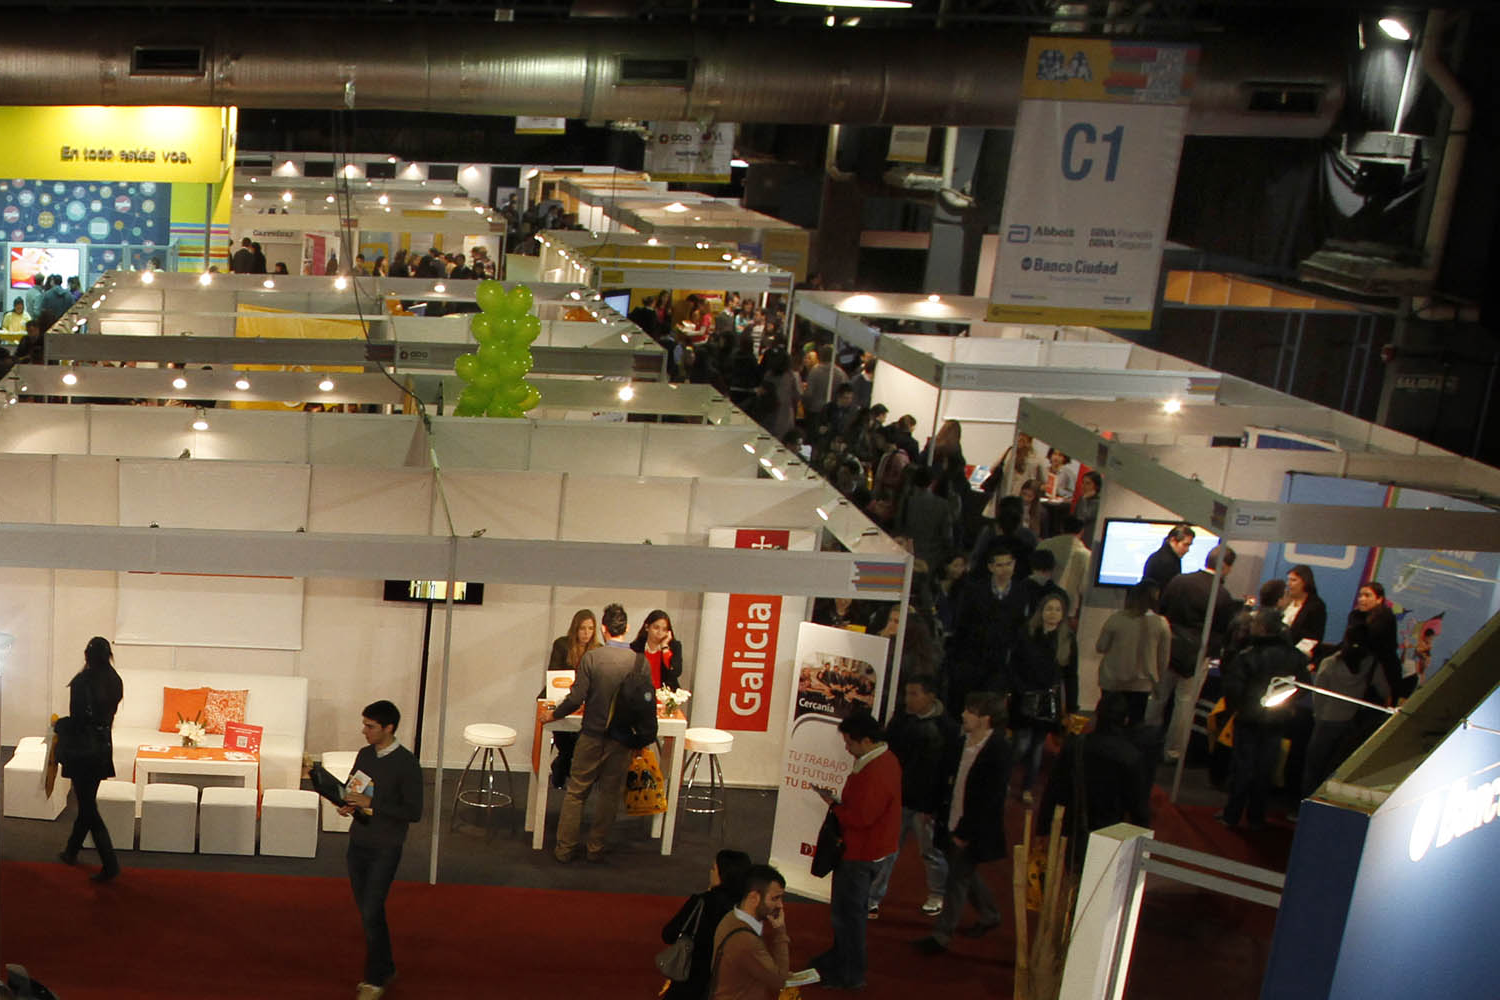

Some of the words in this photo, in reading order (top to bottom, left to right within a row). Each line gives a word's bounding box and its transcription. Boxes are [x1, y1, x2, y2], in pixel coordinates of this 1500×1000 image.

[61, 146, 80, 161] En
[84, 147, 115, 161] todo
[1061, 122, 1125, 182] C1
[1034, 226, 1075, 237] Abbott
[1033, 258, 1073, 273] Banco
[1075, 259, 1119, 275] Ciudad
[729, 602, 772, 716] Galicia
[799, 698, 835, 713] Cercanía
[789, 750, 801, 761] TU
[804, 752, 849, 773] TRABAJO
[785, 776, 799, 788] TU
[787, 763, 799, 774] TU
[803, 766, 844, 785] FUTURO
